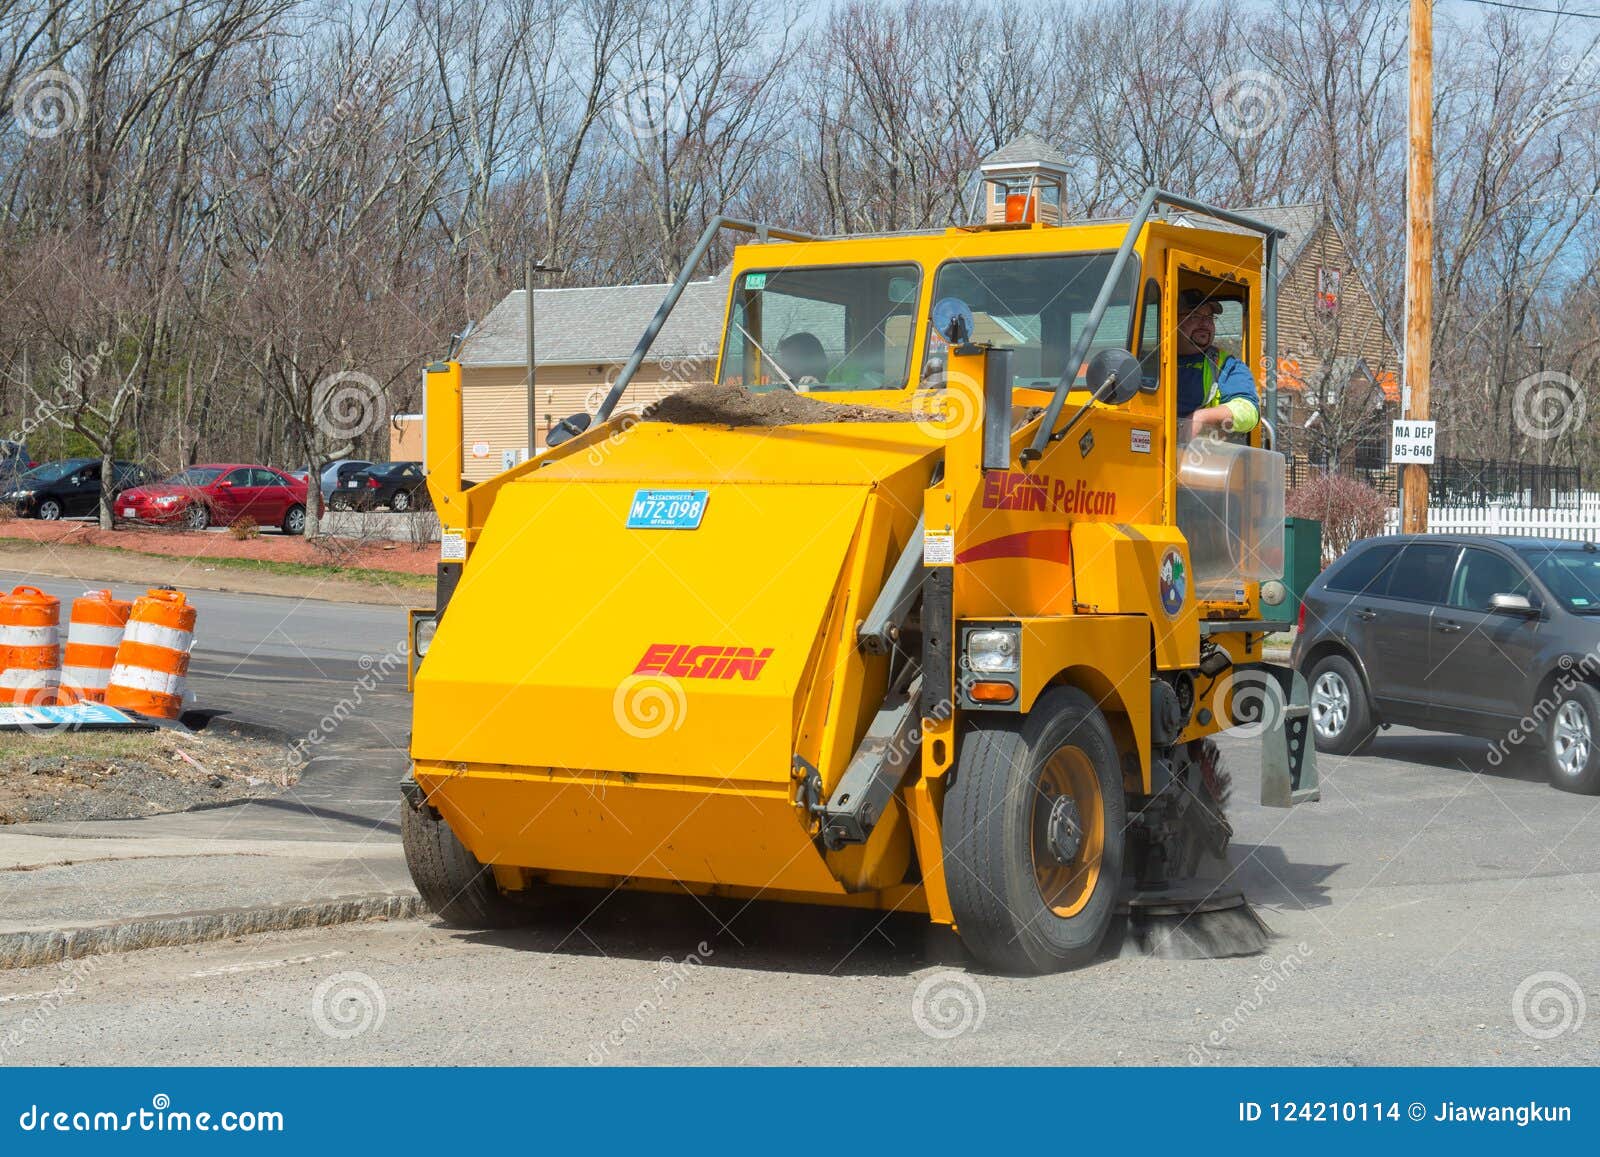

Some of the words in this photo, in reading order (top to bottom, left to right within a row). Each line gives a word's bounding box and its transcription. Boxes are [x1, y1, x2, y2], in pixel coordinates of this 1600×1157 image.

[1395, 426, 1410, 438] MA
[1414, 426, 1434, 439] DEP
[1394, 444, 1433, 457] 95-646
[982, 470, 1049, 512] ELGIN
[1052, 479, 1117, 516] Pelican
[632, 643, 775, 681] ELGIN
